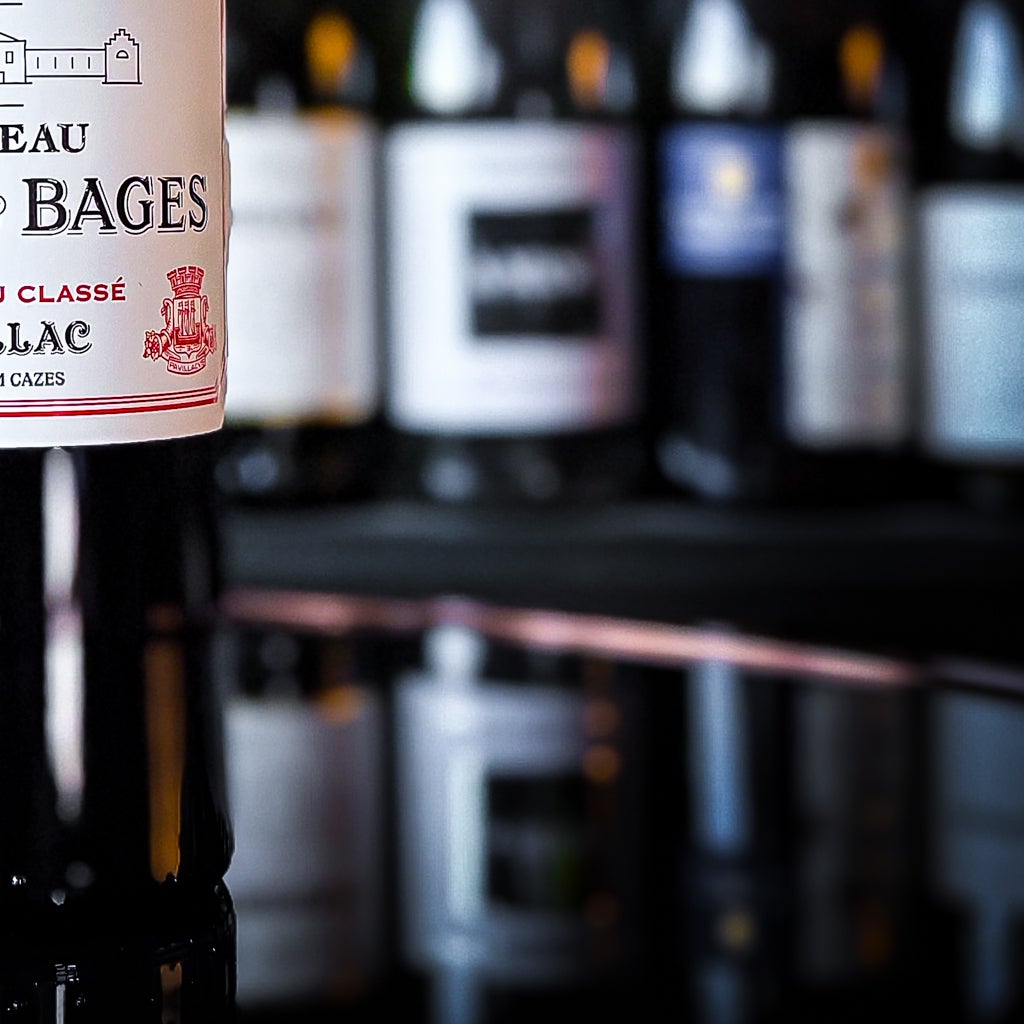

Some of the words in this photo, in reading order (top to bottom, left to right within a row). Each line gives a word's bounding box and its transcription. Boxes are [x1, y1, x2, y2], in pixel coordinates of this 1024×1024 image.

[21, 174, 208, 236] BAGES
[18, 276, 126, 302] CLASSÉ
[10, 371, 66, 387] CAZES
